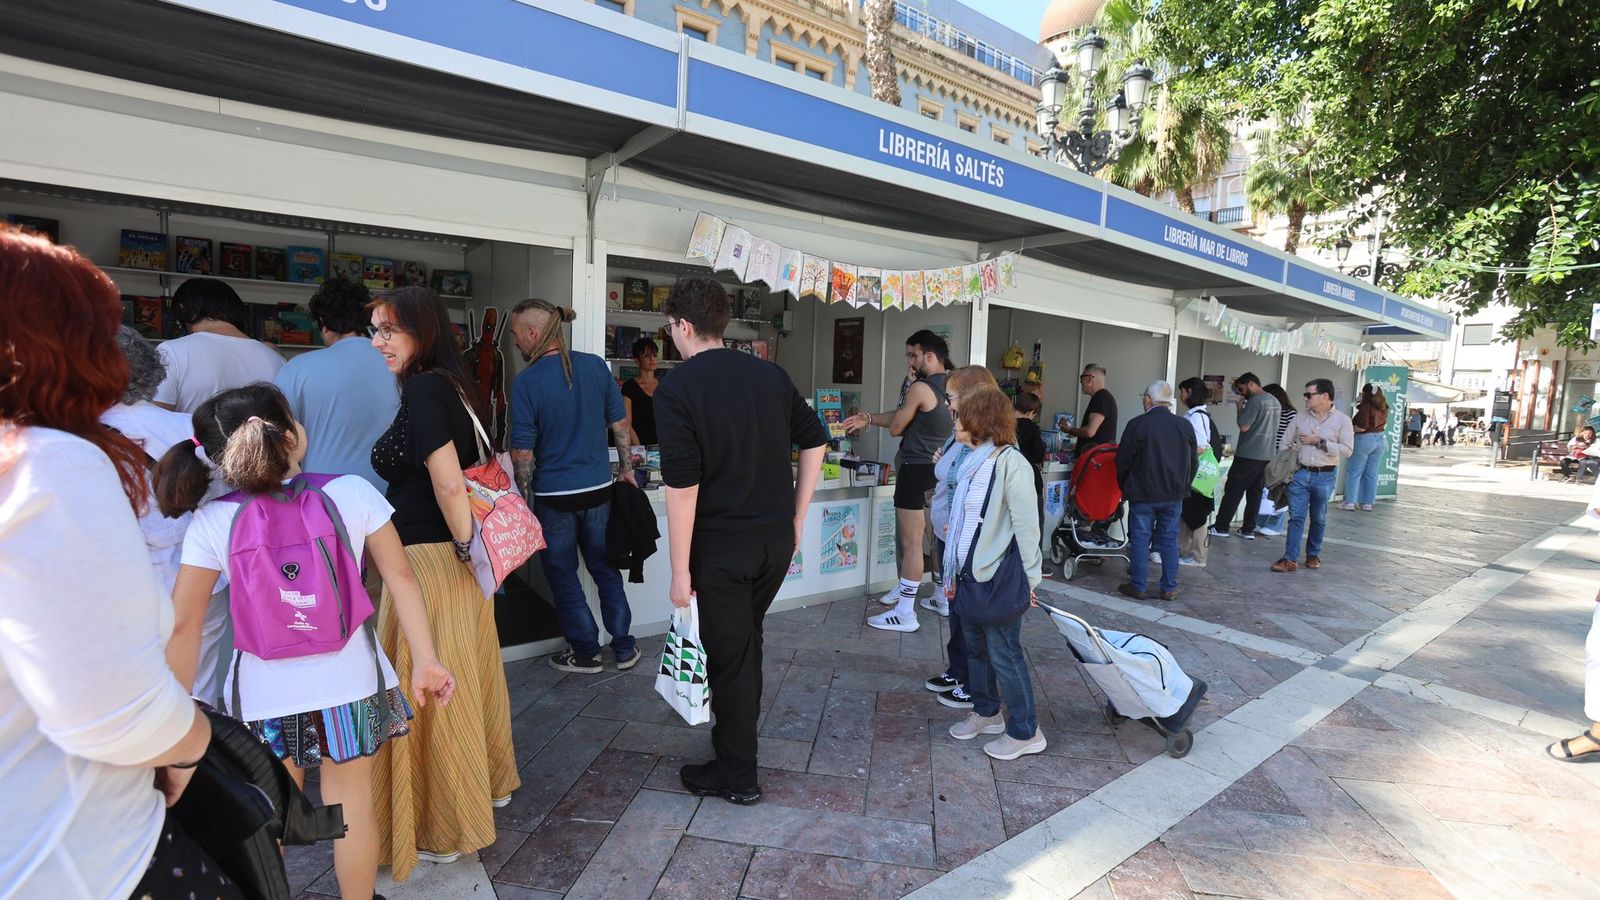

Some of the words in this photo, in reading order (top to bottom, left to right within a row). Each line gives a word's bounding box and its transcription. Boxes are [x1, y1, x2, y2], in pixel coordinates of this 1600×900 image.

[879, 128, 951, 172] LIBRERÍA
[955, 153, 1005, 188] SALTÉS
[1164, 224, 1198, 251] LIBRERÍA
[1199, 236, 1216, 257] MAR
[1216, 243, 1226, 260] DE
[1225, 246, 1249, 267] LIBROS
[1386, 393, 1407, 472] Fundación
